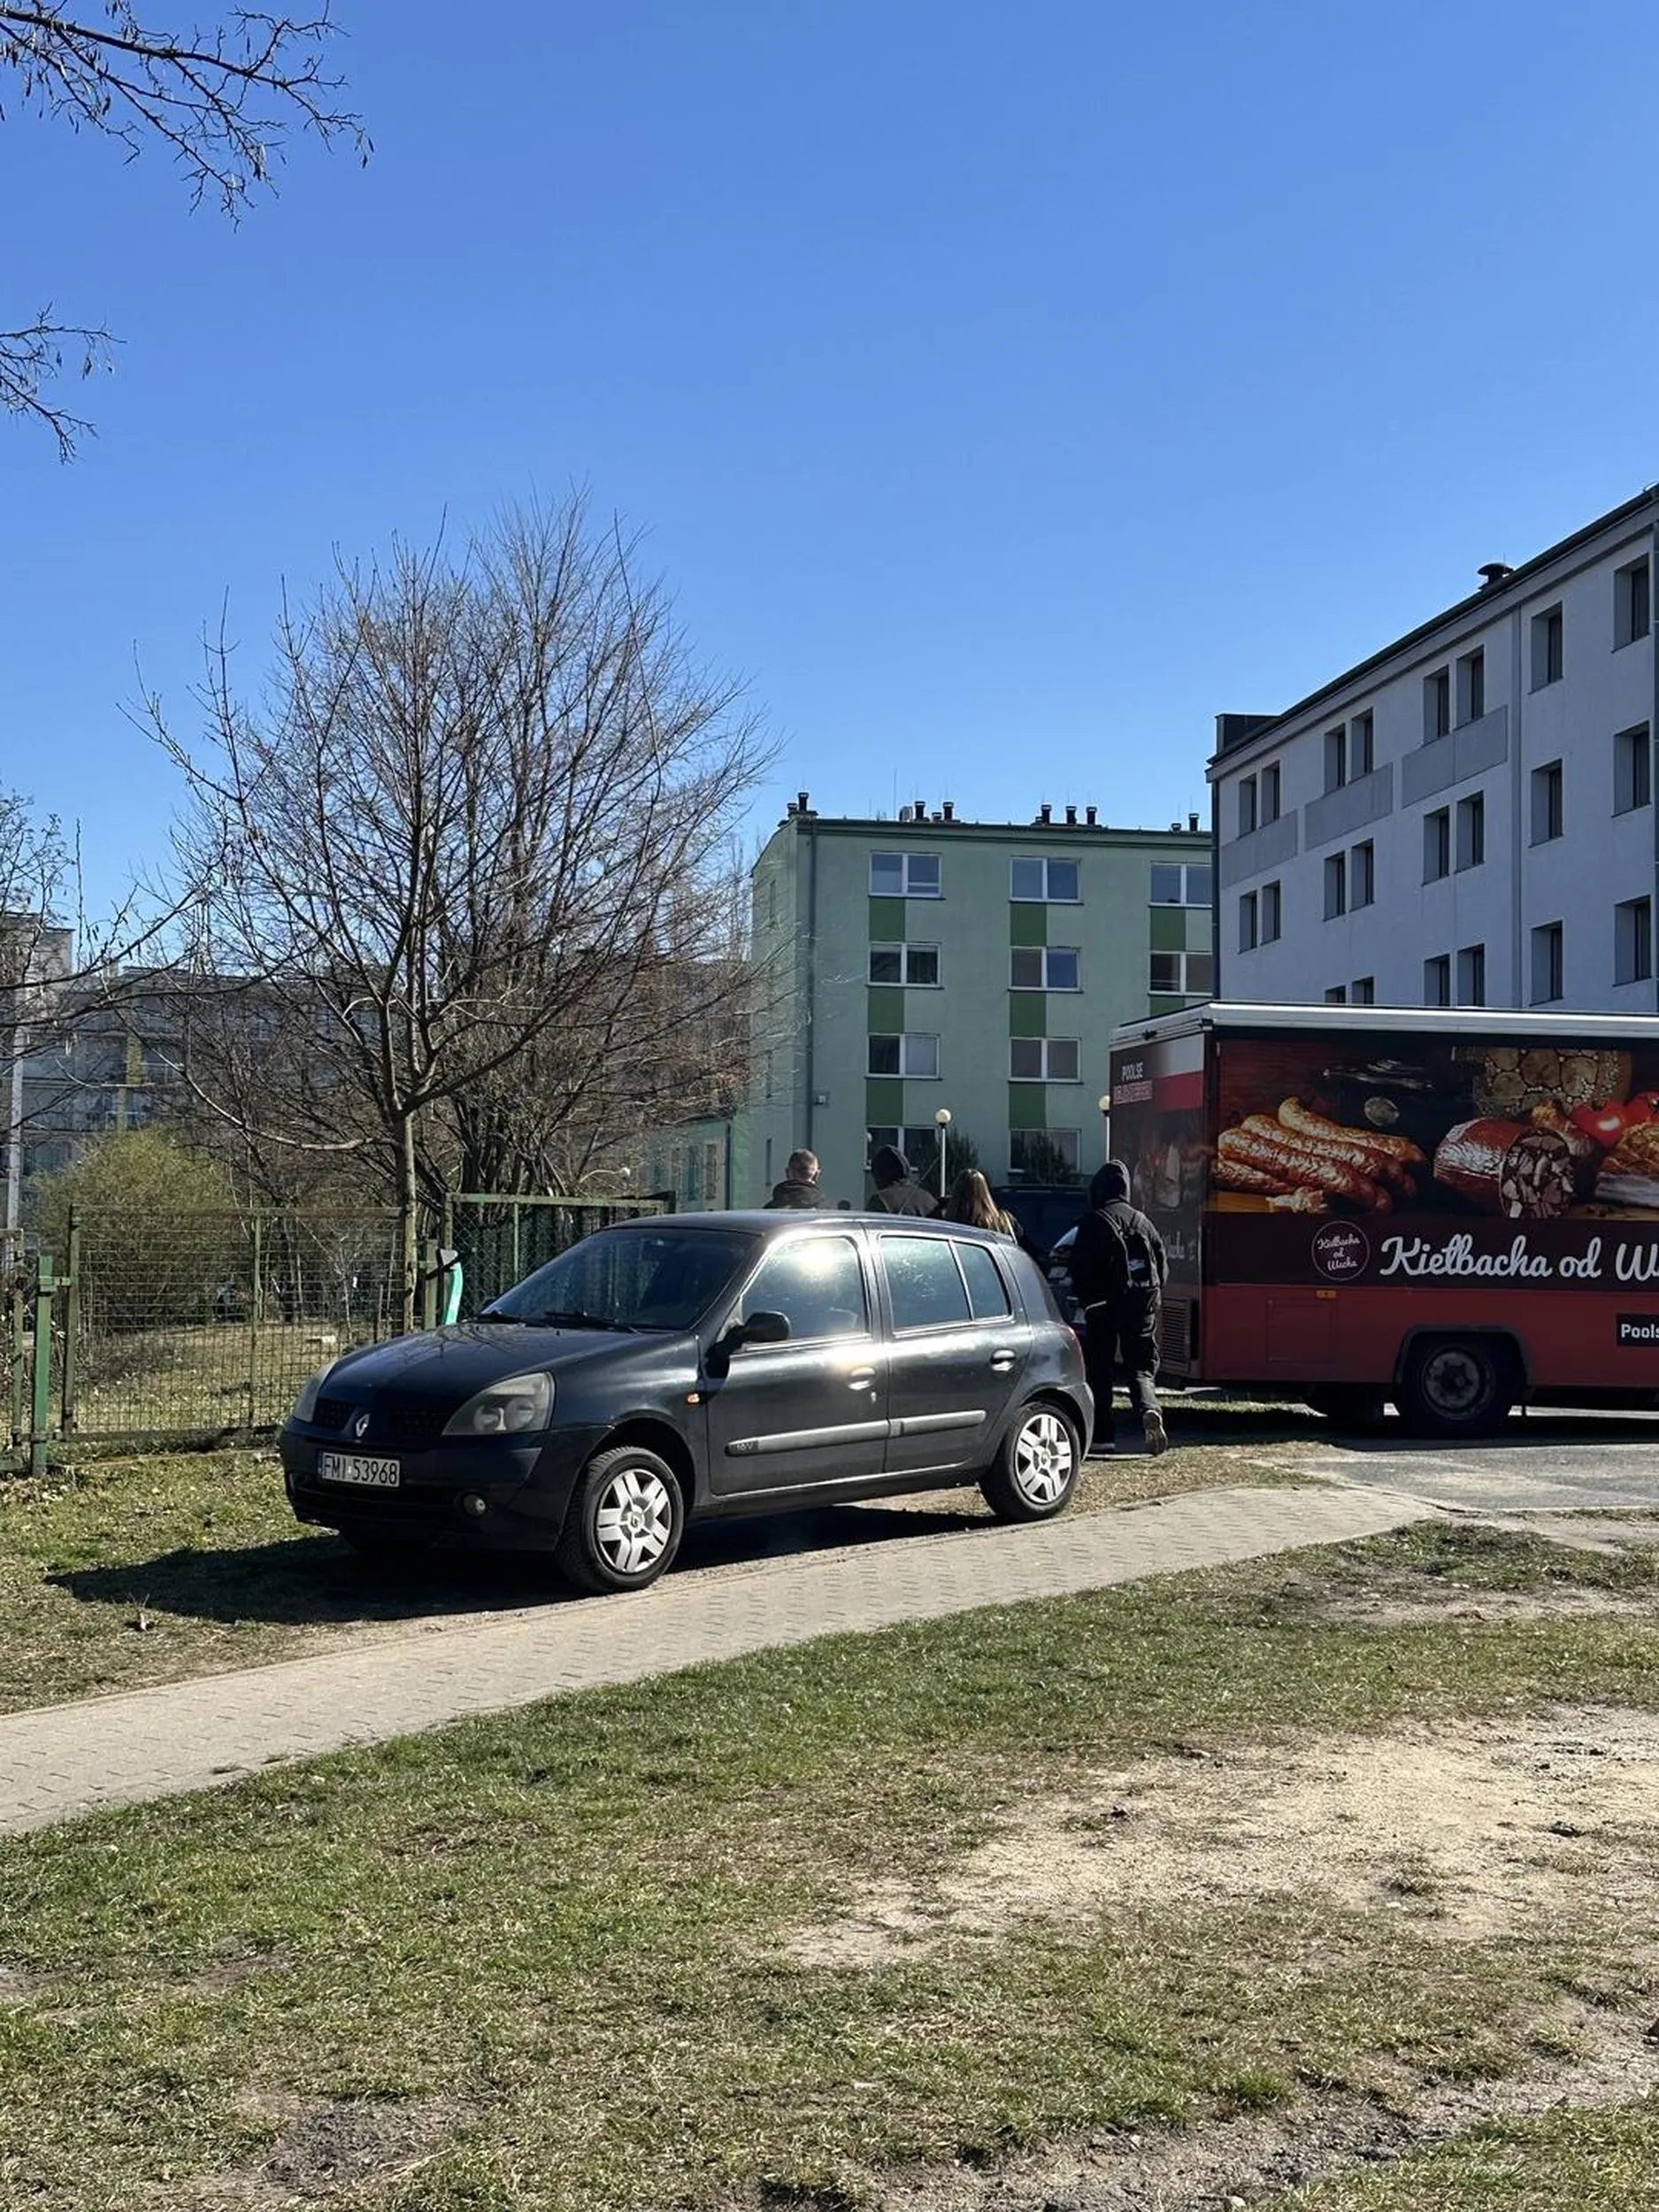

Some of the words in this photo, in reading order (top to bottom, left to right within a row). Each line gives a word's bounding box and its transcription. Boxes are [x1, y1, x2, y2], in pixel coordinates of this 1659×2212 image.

[1558, 1236, 1602, 1279] od
[1615, 1242, 1659, 1282] W
[352, 1457, 398, 1485] 53968
